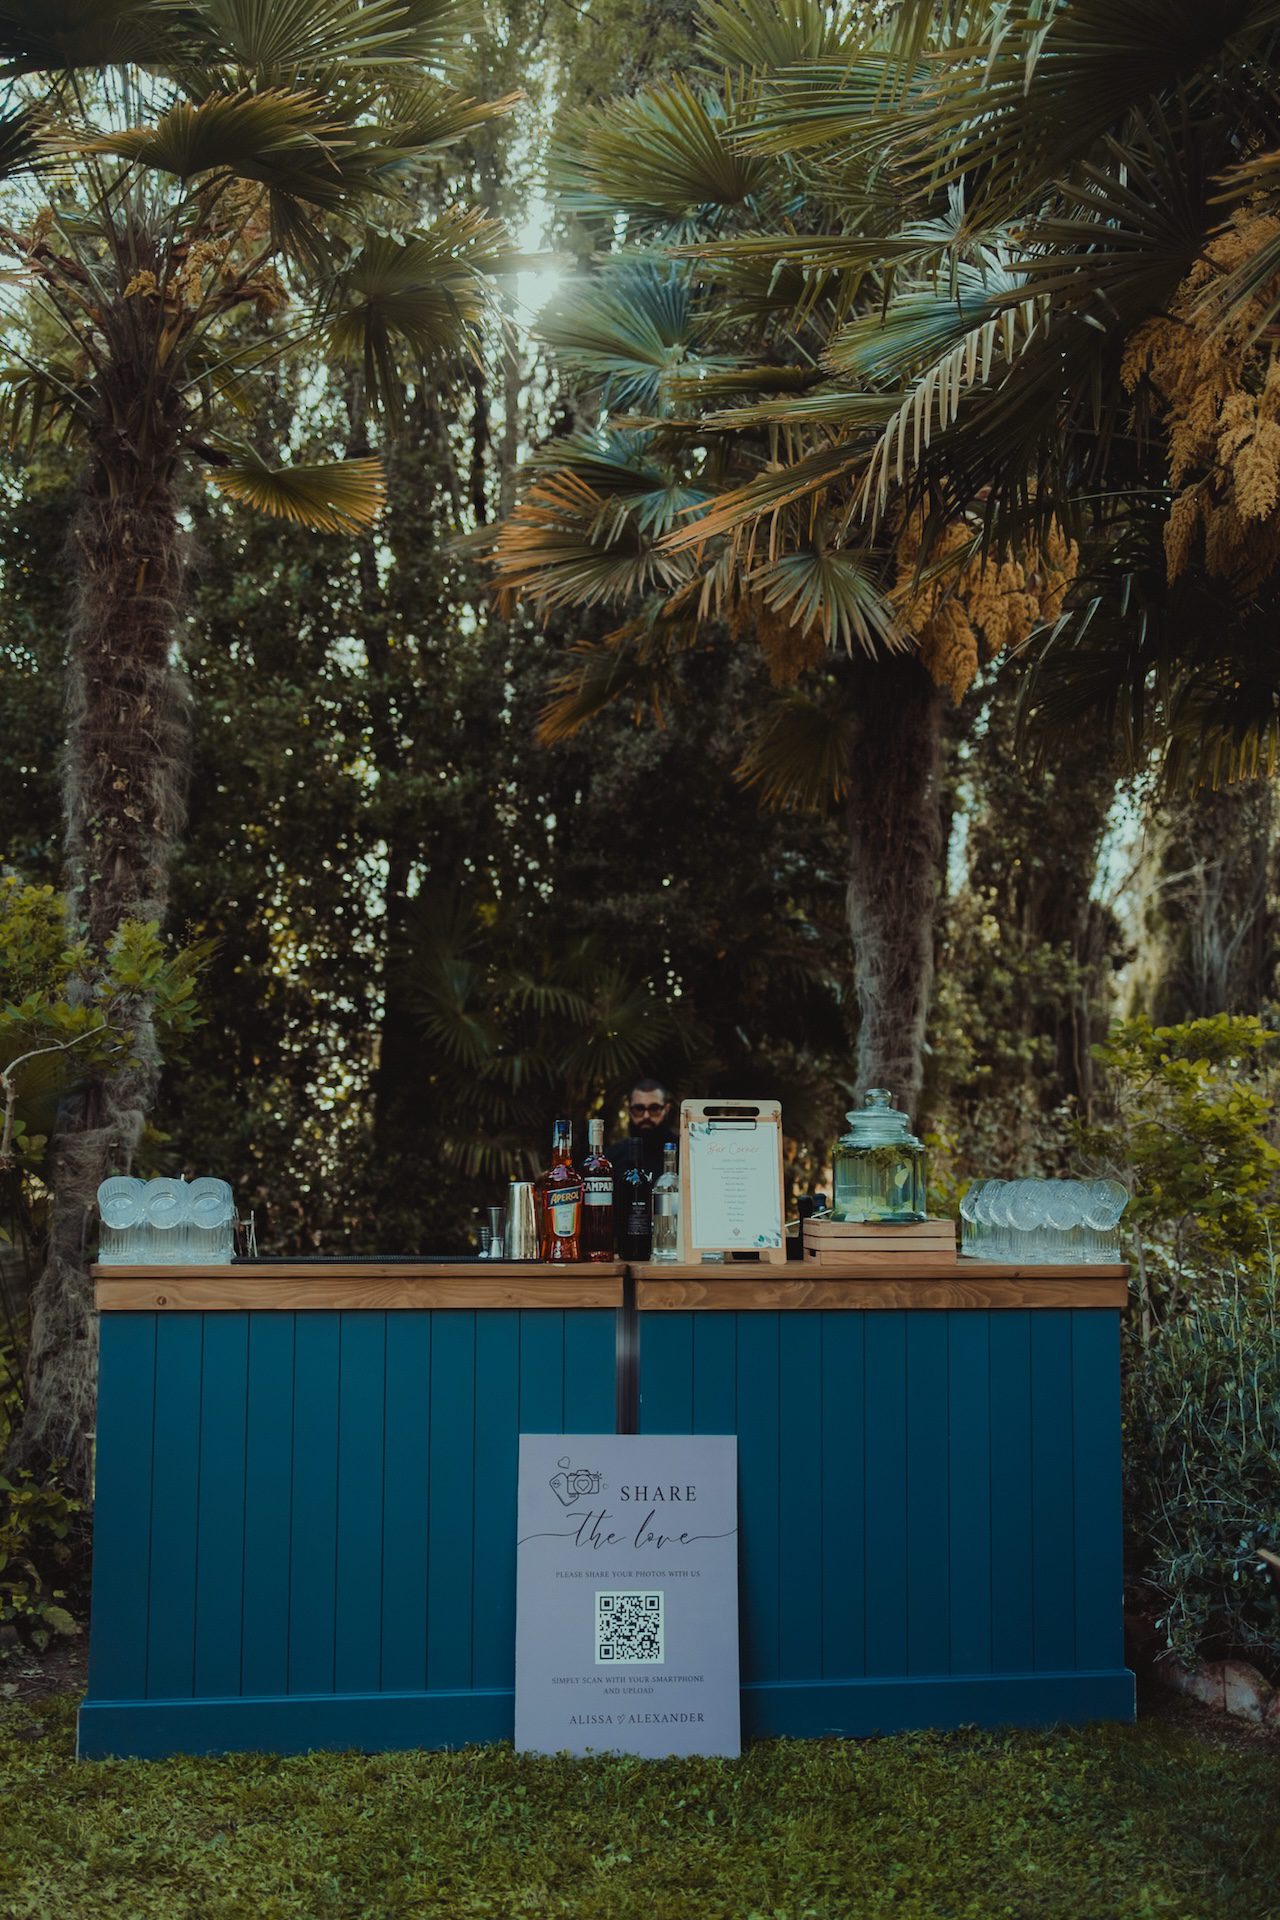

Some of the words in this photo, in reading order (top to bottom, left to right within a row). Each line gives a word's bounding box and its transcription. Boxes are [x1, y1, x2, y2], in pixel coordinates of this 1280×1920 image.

[550, 1191, 580, 1205] APEROL
[620, 1485, 697, 1502] SHARE
[562, 1509, 627, 1550] the
[634, 1509, 697, 1549] love
[555, 1570, 583, 1578] PLEASE
[585, 1570, 610, 1578] SHARE
[612, 1570, 633, 1578] YOUR
[635, 1570, 666, 1578] PHOTOS
[668, 1570, 689, 1578] WITH
[552, 1677, 580, 1685] SIMPLY
[582, 1676, 603, 1684] SCAN
[628, 1675, 650, 1683] YOUR
[651, 1675, 705, 1683] SMARTPHONE
[603, 1687, 620, 1695] AND
[622, 1687, 654, 1695] UPLOAD
[569, 1714, 613, 1725] ALISSA
[628, 1712, 705, 1724] ALEXANDER
